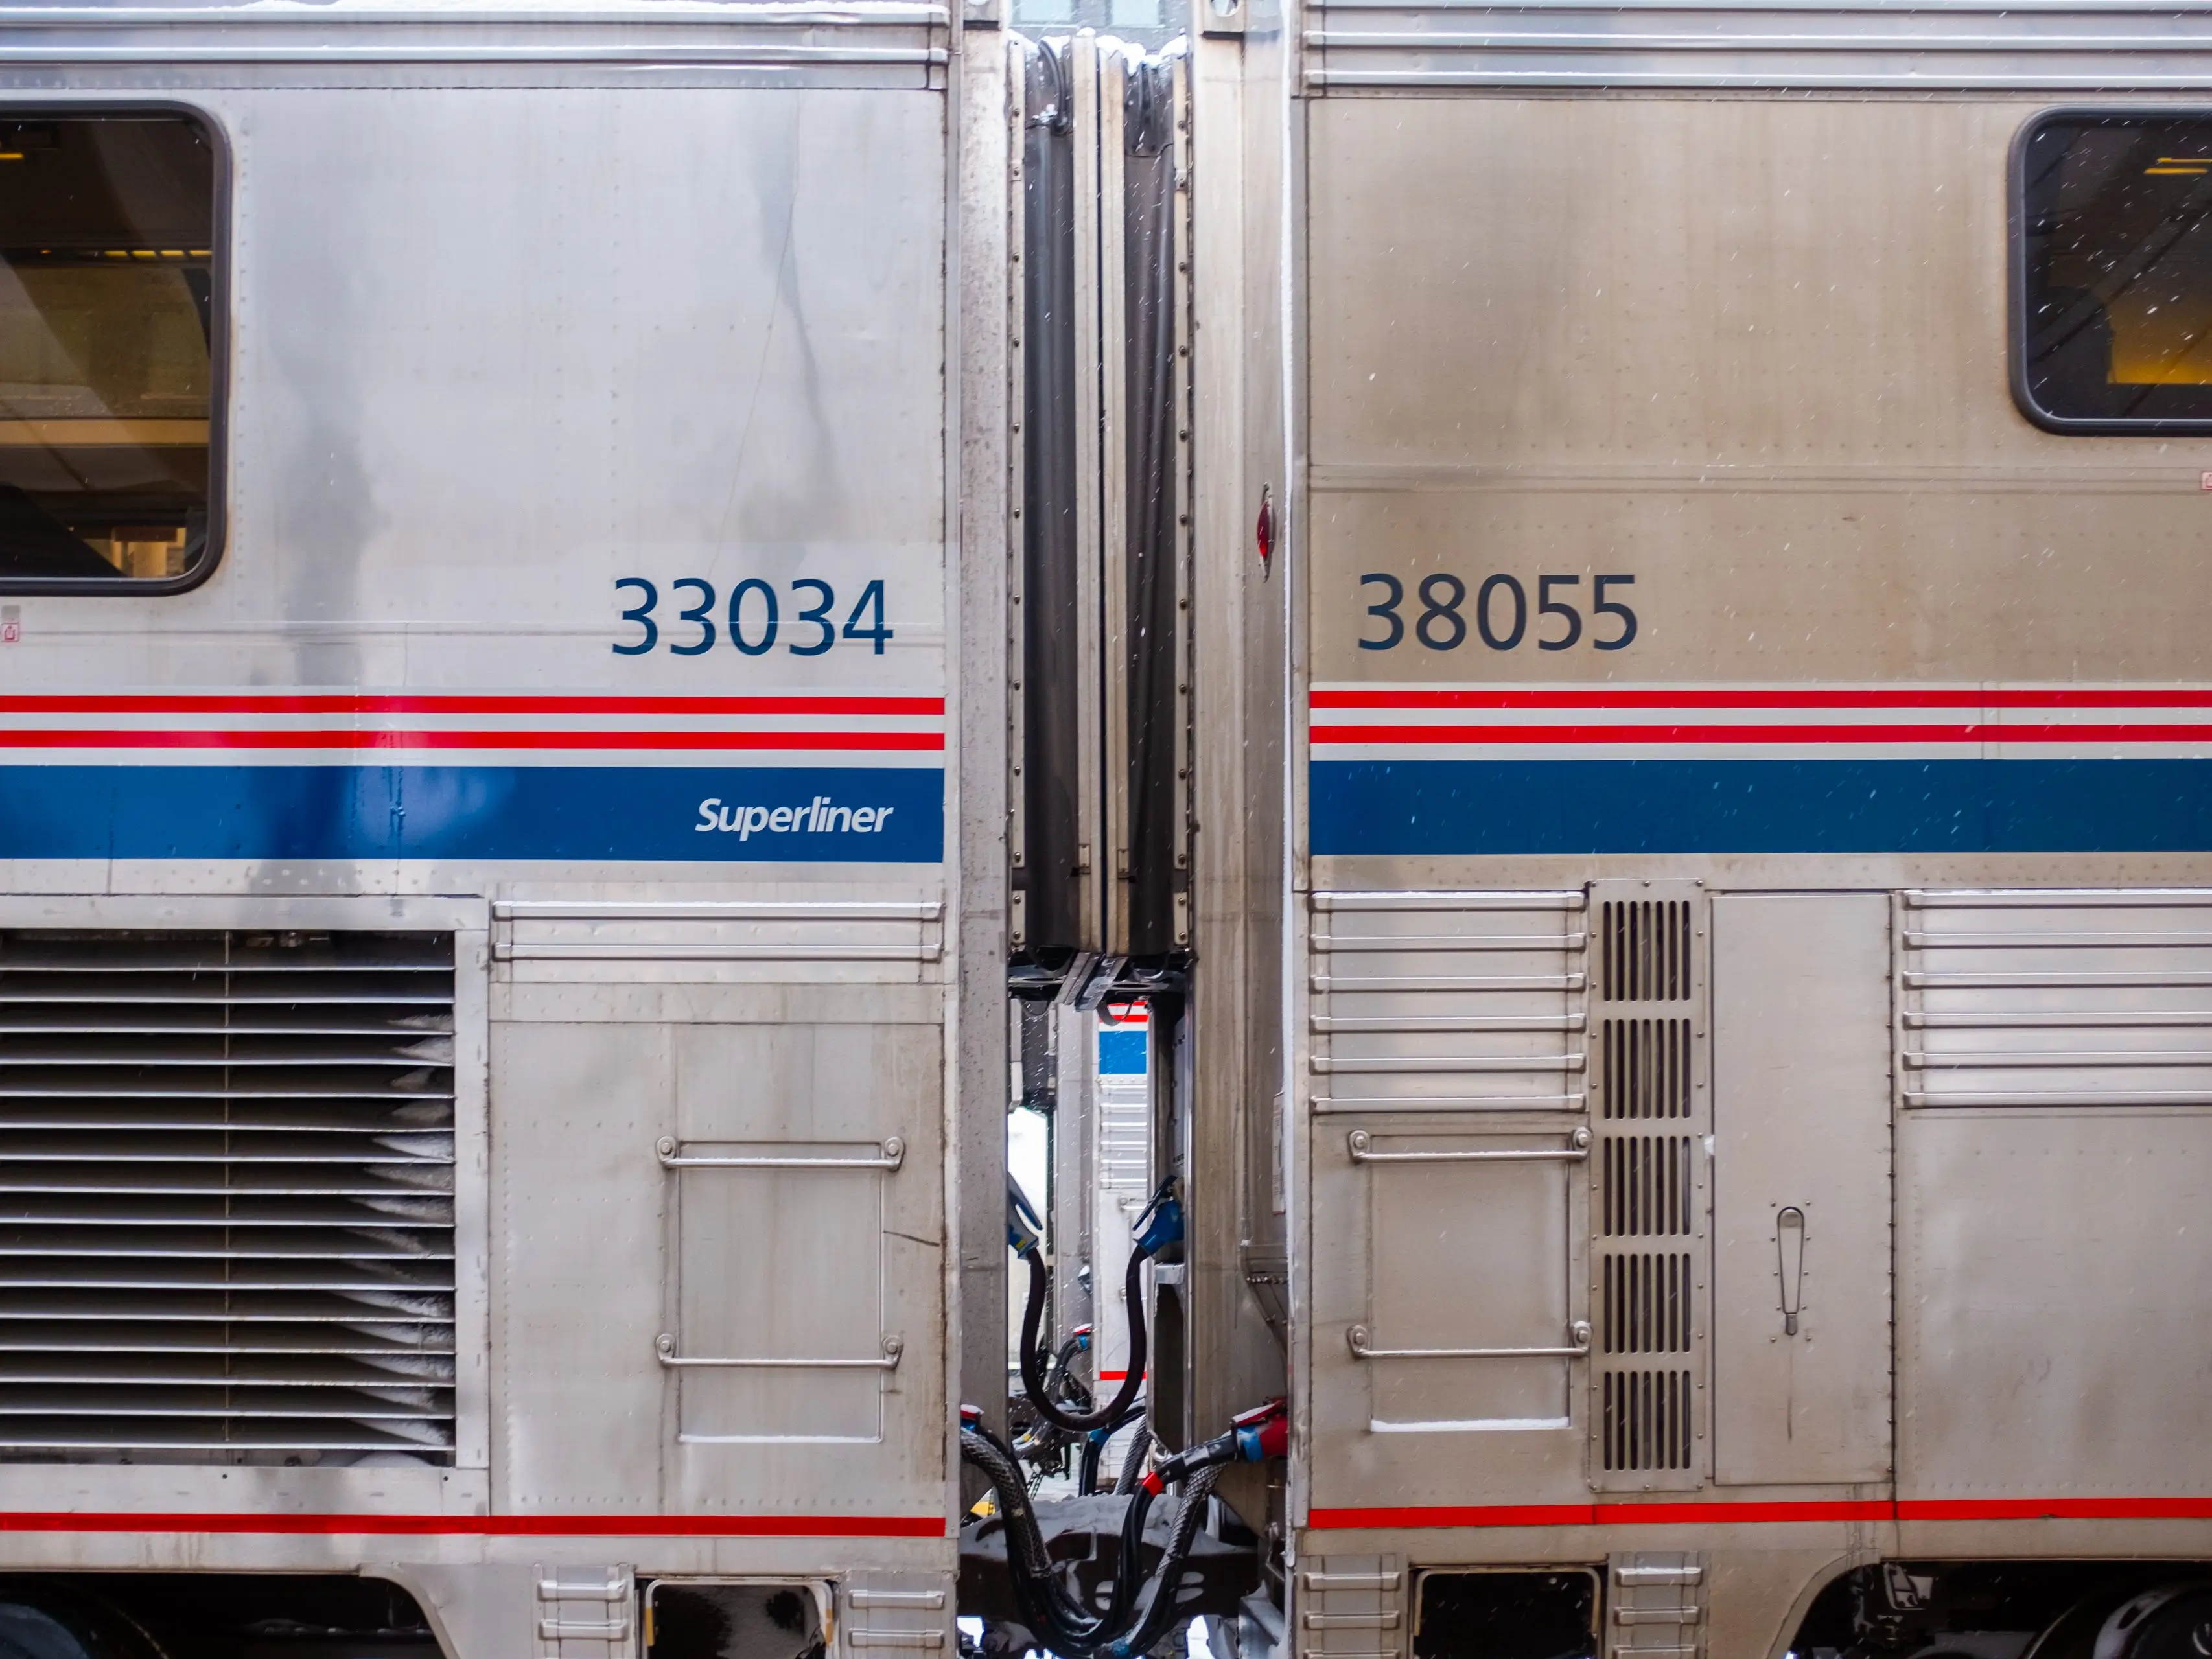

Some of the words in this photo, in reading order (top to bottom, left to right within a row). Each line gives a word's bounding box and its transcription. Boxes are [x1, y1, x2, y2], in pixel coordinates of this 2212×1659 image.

[612, 577, 894, 656] 33034
[1358, 573, 1638, 651] 38055
[695, 796, 894, 841] Superliner
